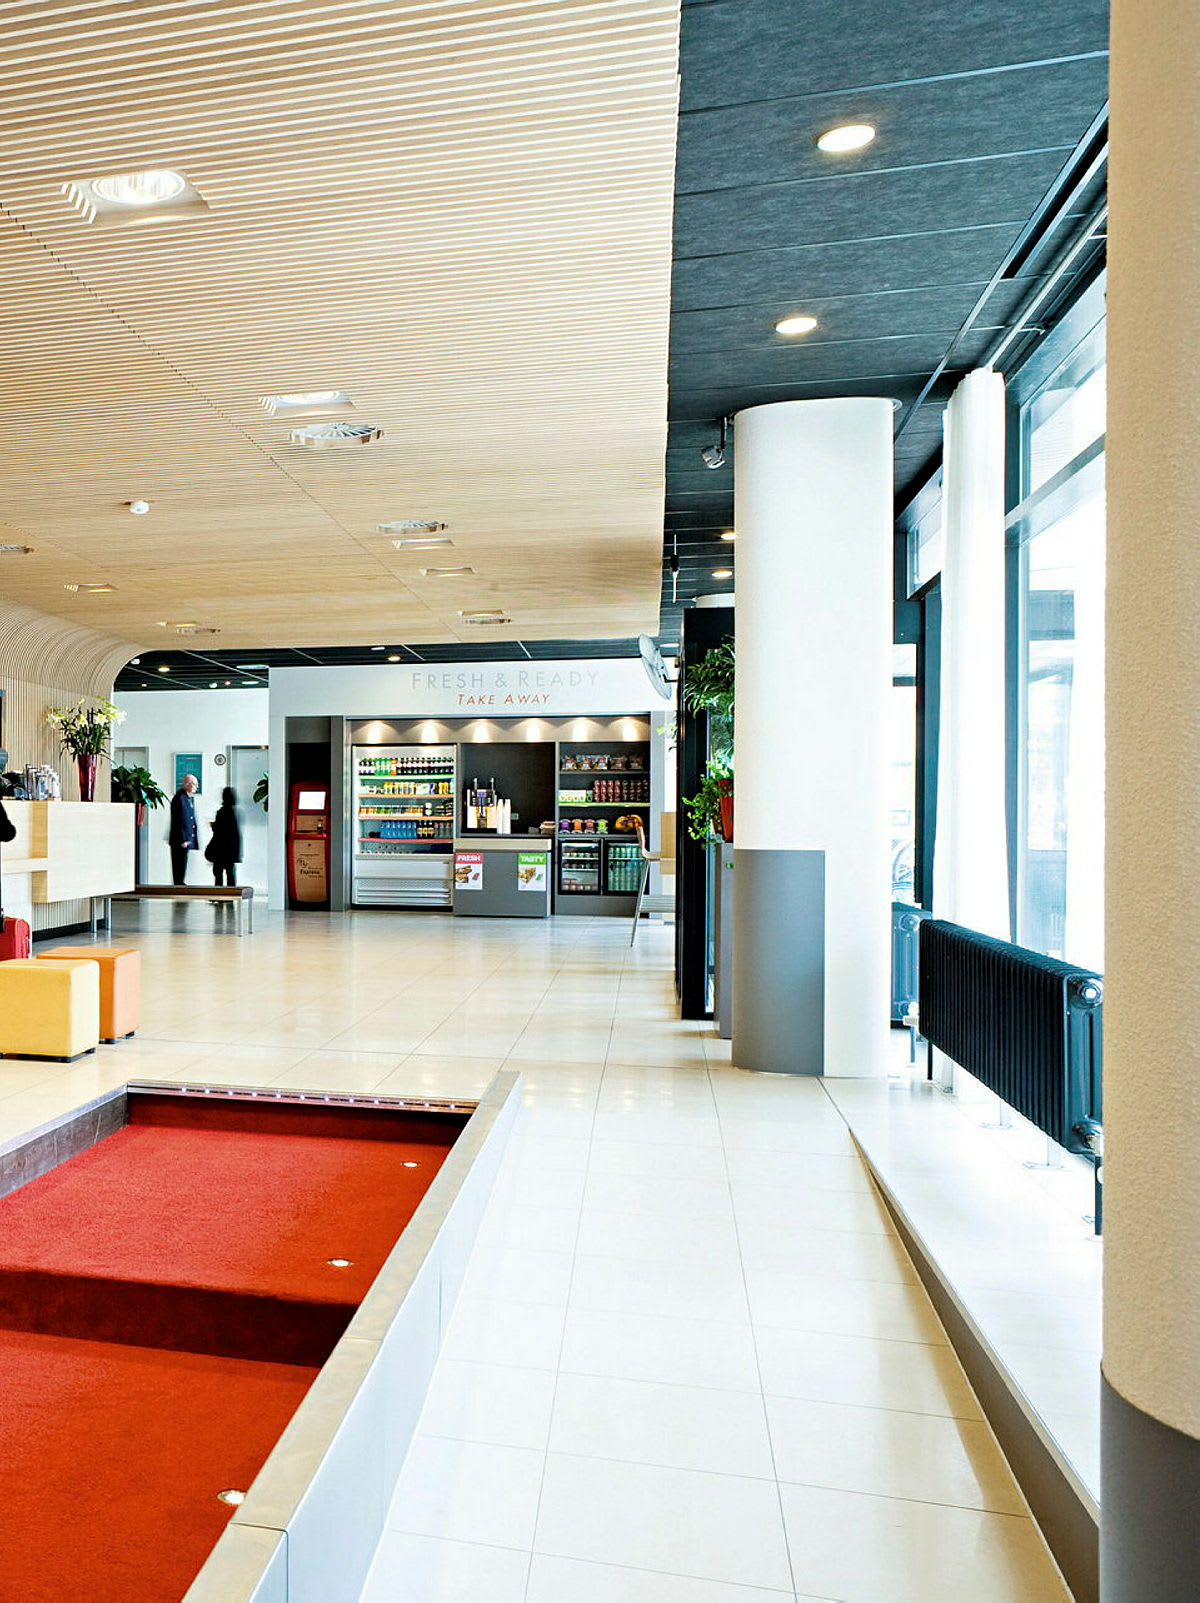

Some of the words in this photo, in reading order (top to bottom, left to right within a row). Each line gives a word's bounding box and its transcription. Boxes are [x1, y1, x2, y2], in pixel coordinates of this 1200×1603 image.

[412, 672, 483, 689] FRESH
[495, 672, 508, 688] &
[519, 670, 599, 688] READY
[458, 693, 496, 705] TAKE
[504, 693, 550, 705] AWAY
